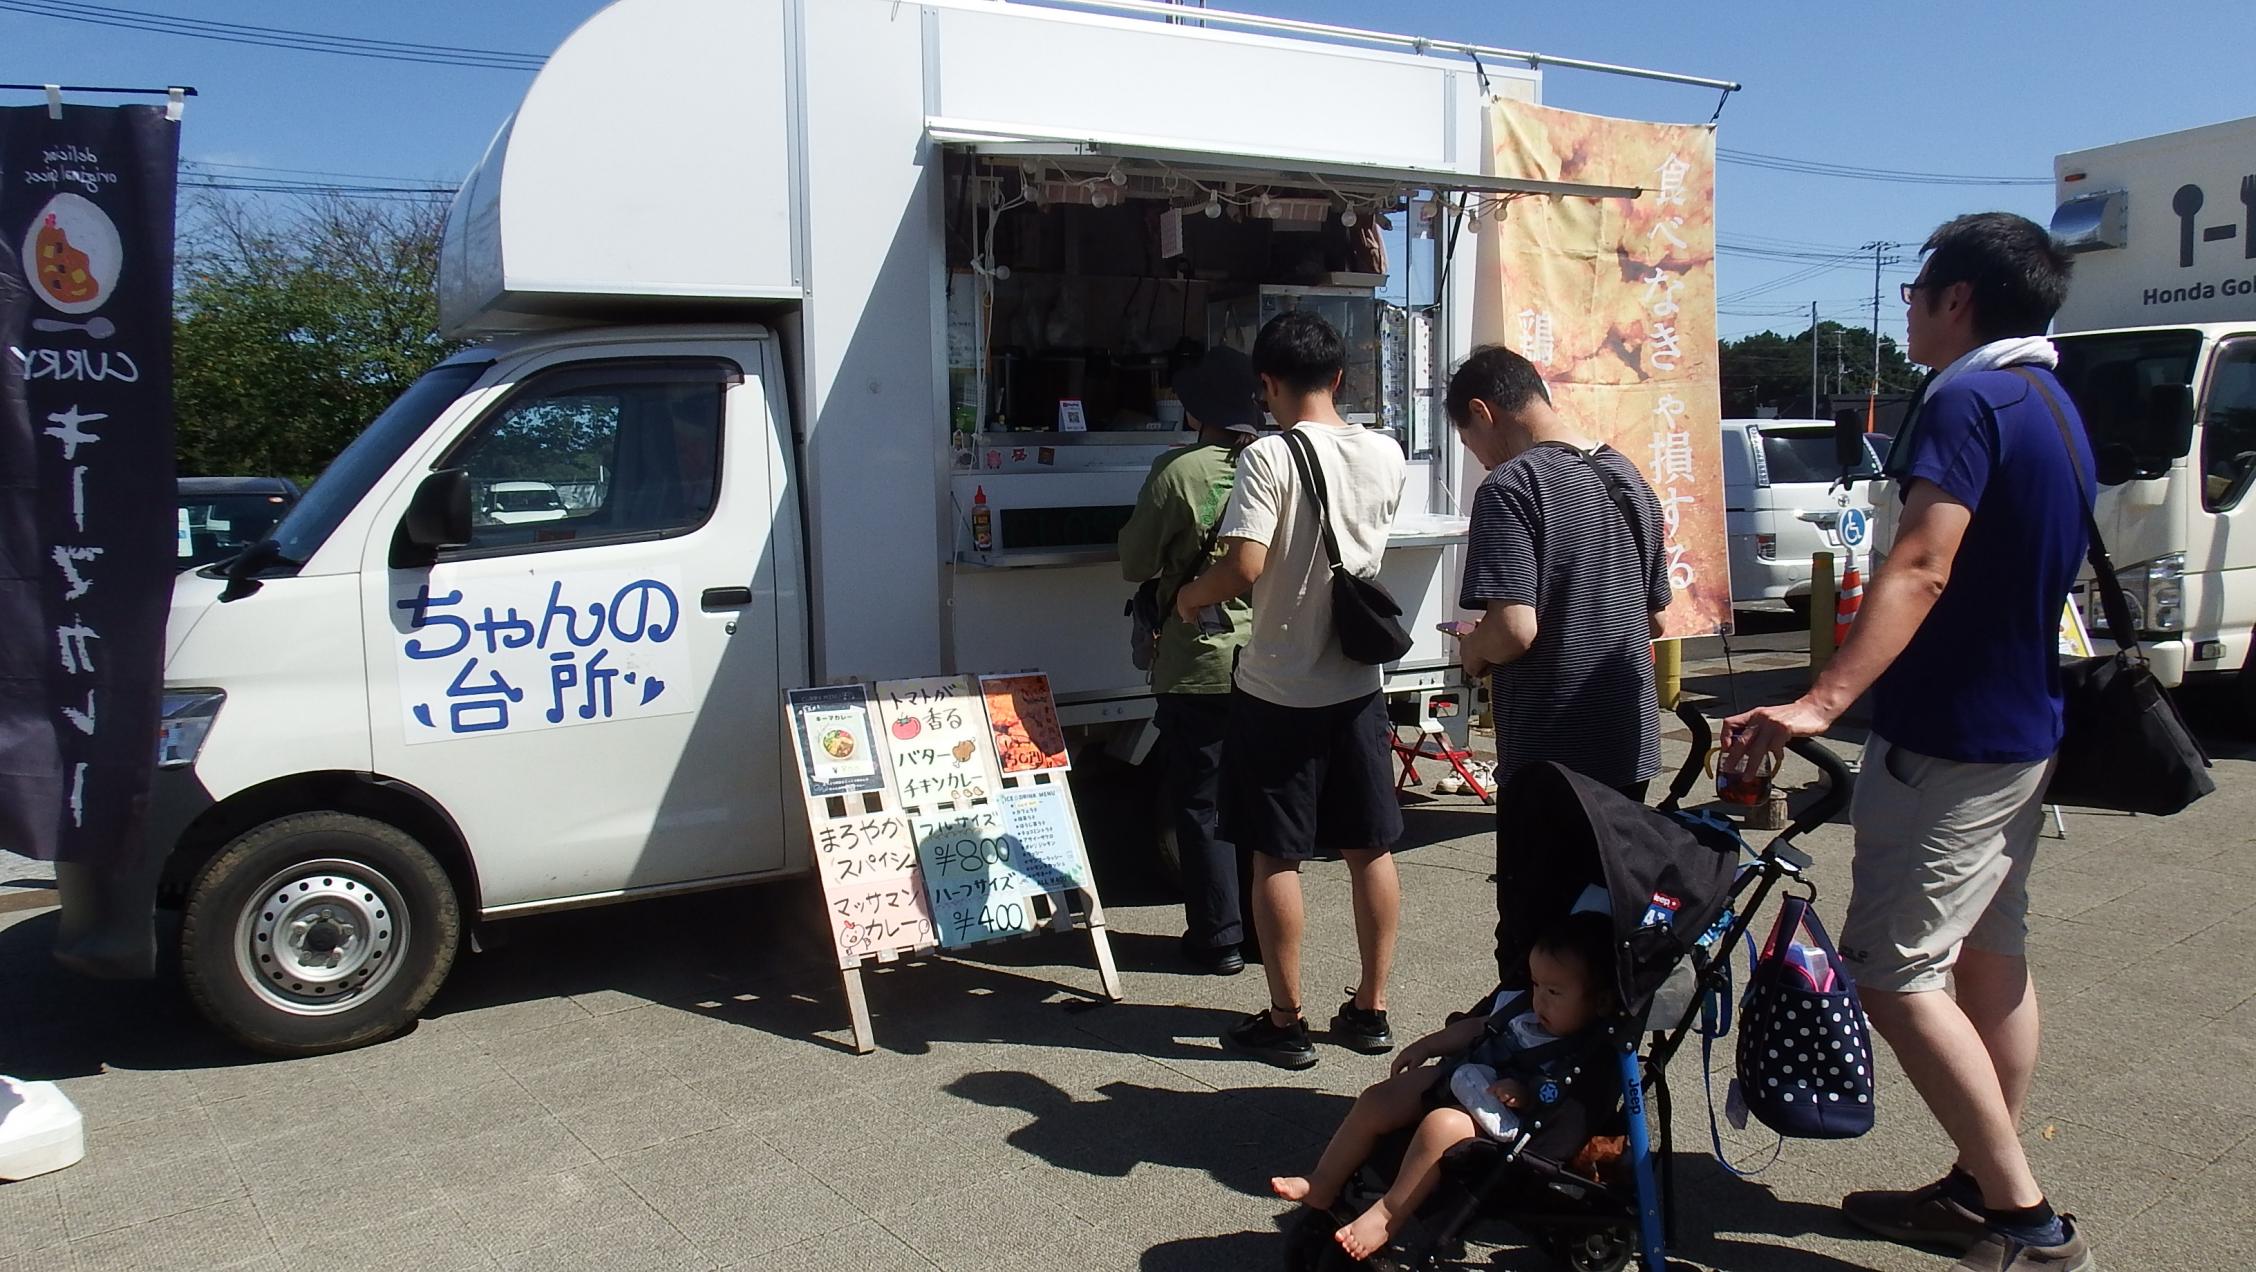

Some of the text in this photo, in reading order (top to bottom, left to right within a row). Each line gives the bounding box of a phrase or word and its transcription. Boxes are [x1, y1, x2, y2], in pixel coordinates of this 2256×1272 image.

[2143, 275, 2256, 306] Honda Go
[1643, 152, 1697, 590] 食べなきゃ損する
[397, 579, 680, 660] ちゃんの
[446, 648, 620, 733] 台所
[890, 683, 957, 710] トマトが
[922, 707, 962, 735] 香る
[899, 748, 951, 767] バター
[904, 772, 983, 798] チキンカレー
[819, 817, 904, 853] まろやか
[919, 811, 999, 836] フルサイズ
[837, 852, 918, 879] スパイシー
[934, 836, 1010, 876] ¥800
[833, 889, 919, 916] マッサマン
[936, 871, 1016, 904] ハーフサイズ
[865, 919, 918, 941] カレー
[952, 903, 1023, 941] ¥400
[1628, 1078, 1641, 1114] Jeep
